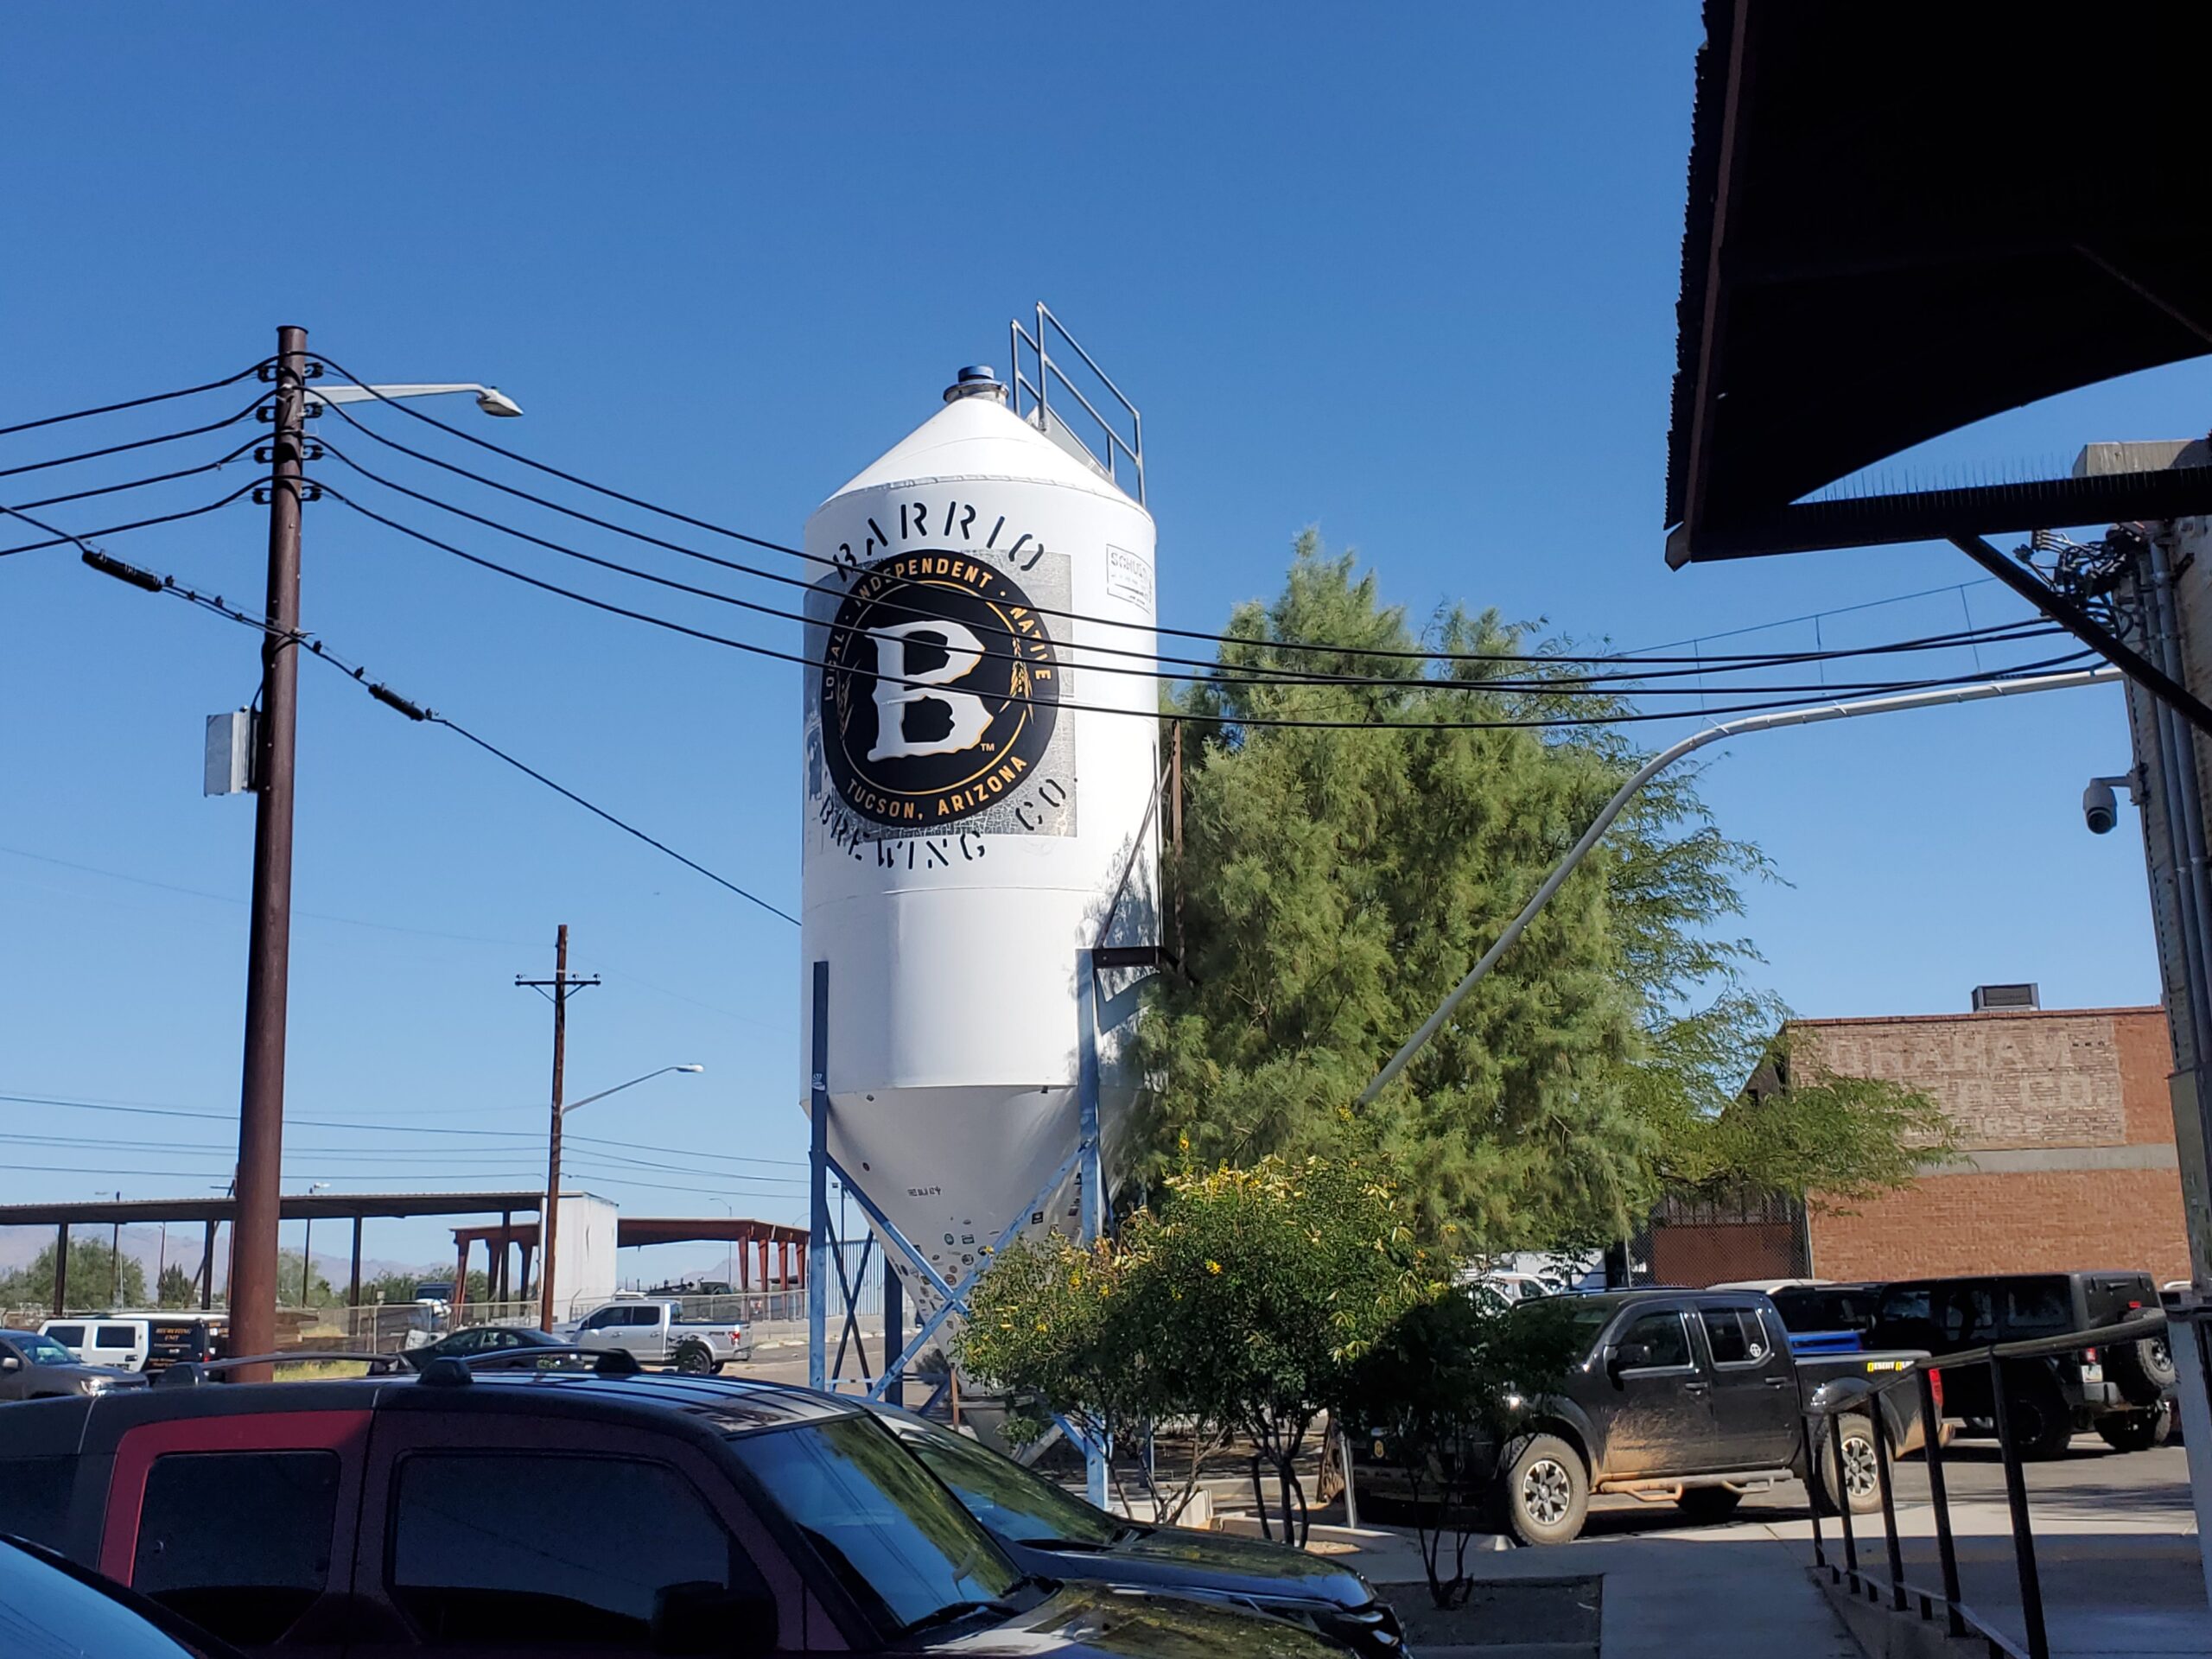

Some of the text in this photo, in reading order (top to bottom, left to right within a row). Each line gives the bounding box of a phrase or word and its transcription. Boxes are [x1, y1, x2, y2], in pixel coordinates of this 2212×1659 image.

[833, 501, 1044, 582] BARRIO
[823, 633, 845, 701] LOCAL
[855, 557, 994, 607] INDEPENDENT
[865, 620, 993, 762] B
[847, 760, 1027, 821] TUCSON, ARIZONA
[820, 794, 985, 869] BREWING
